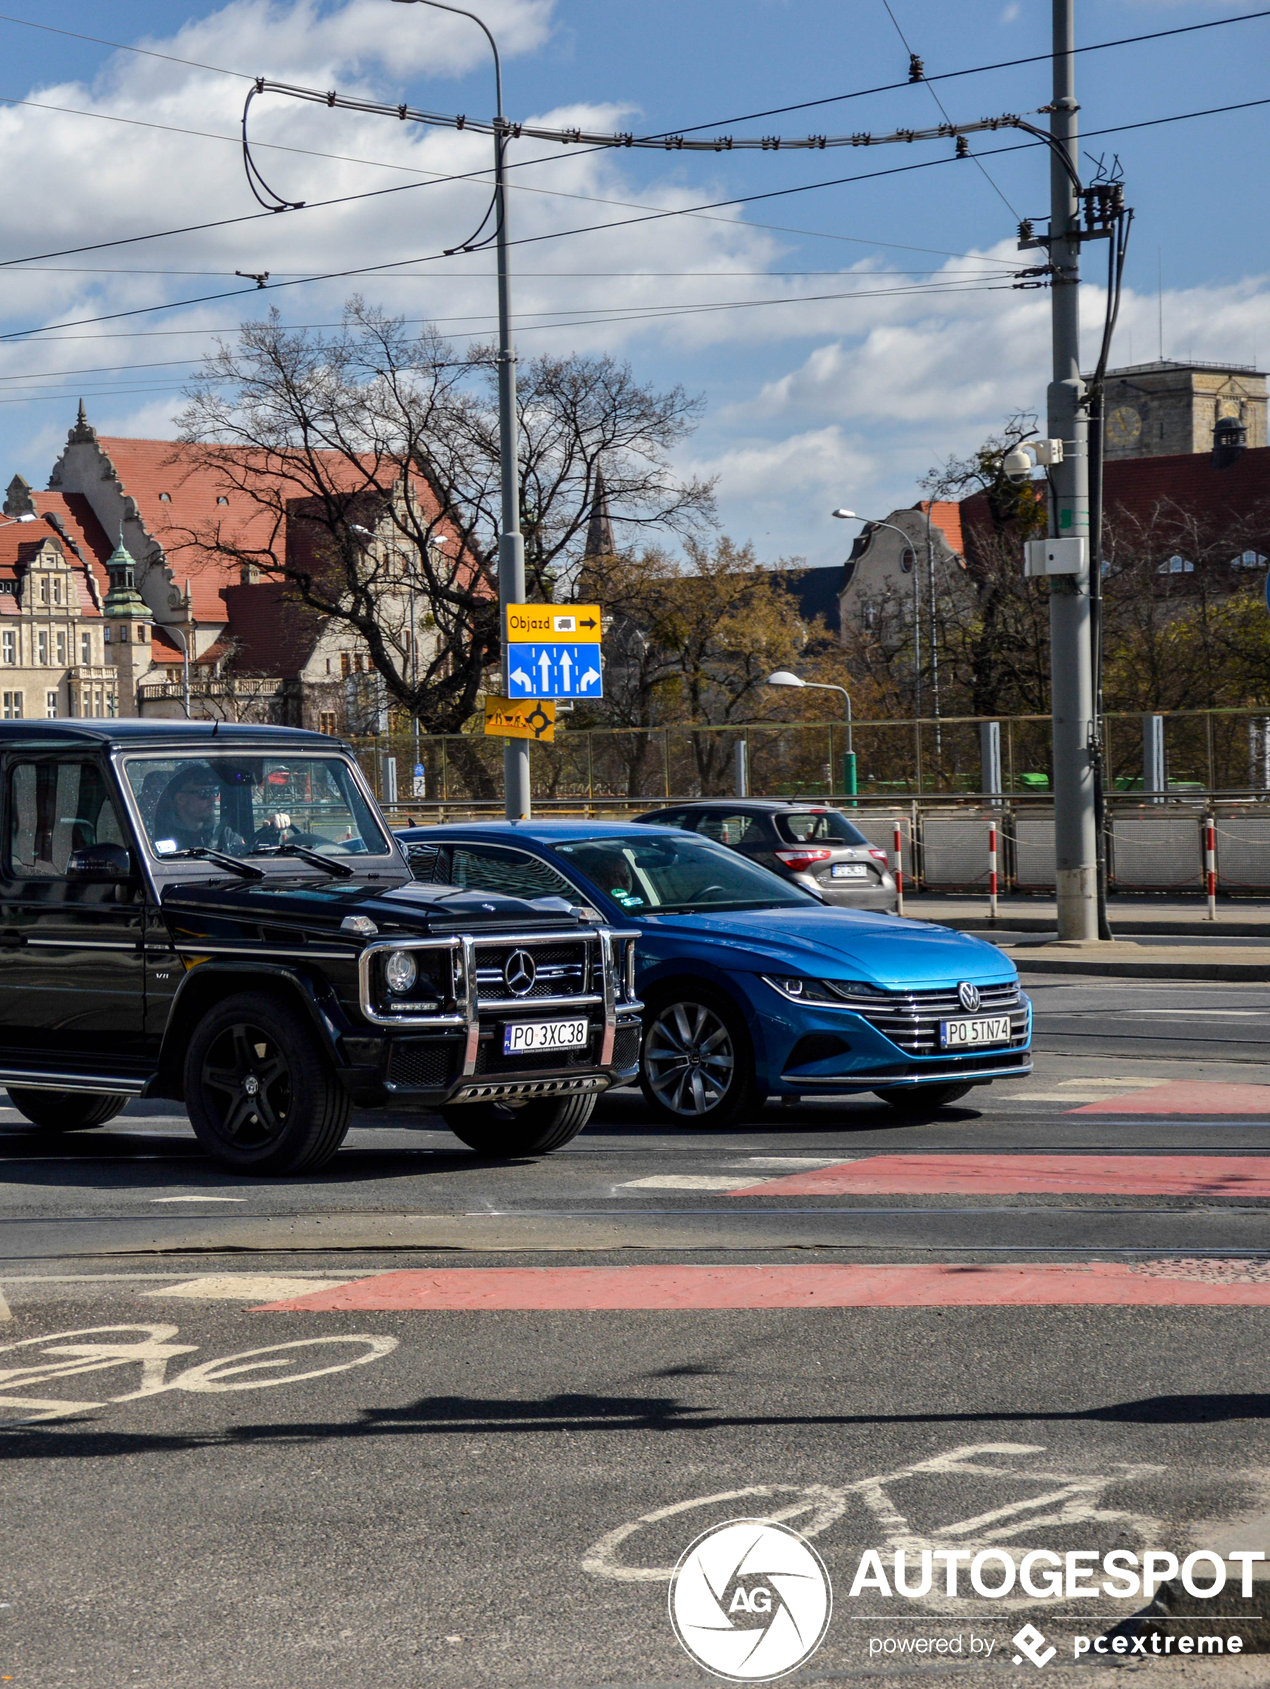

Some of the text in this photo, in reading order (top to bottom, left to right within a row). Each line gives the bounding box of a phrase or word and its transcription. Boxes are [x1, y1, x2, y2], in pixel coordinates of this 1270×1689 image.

[510, 615, 550, 632] Objazd
[514, 1026, 534, 1048] PO
[539, 1023, 584, 1046] 3XC38
[949, 1023, 967, 1042] PO
[971, 1019, 1008, 1040] 5TN74
